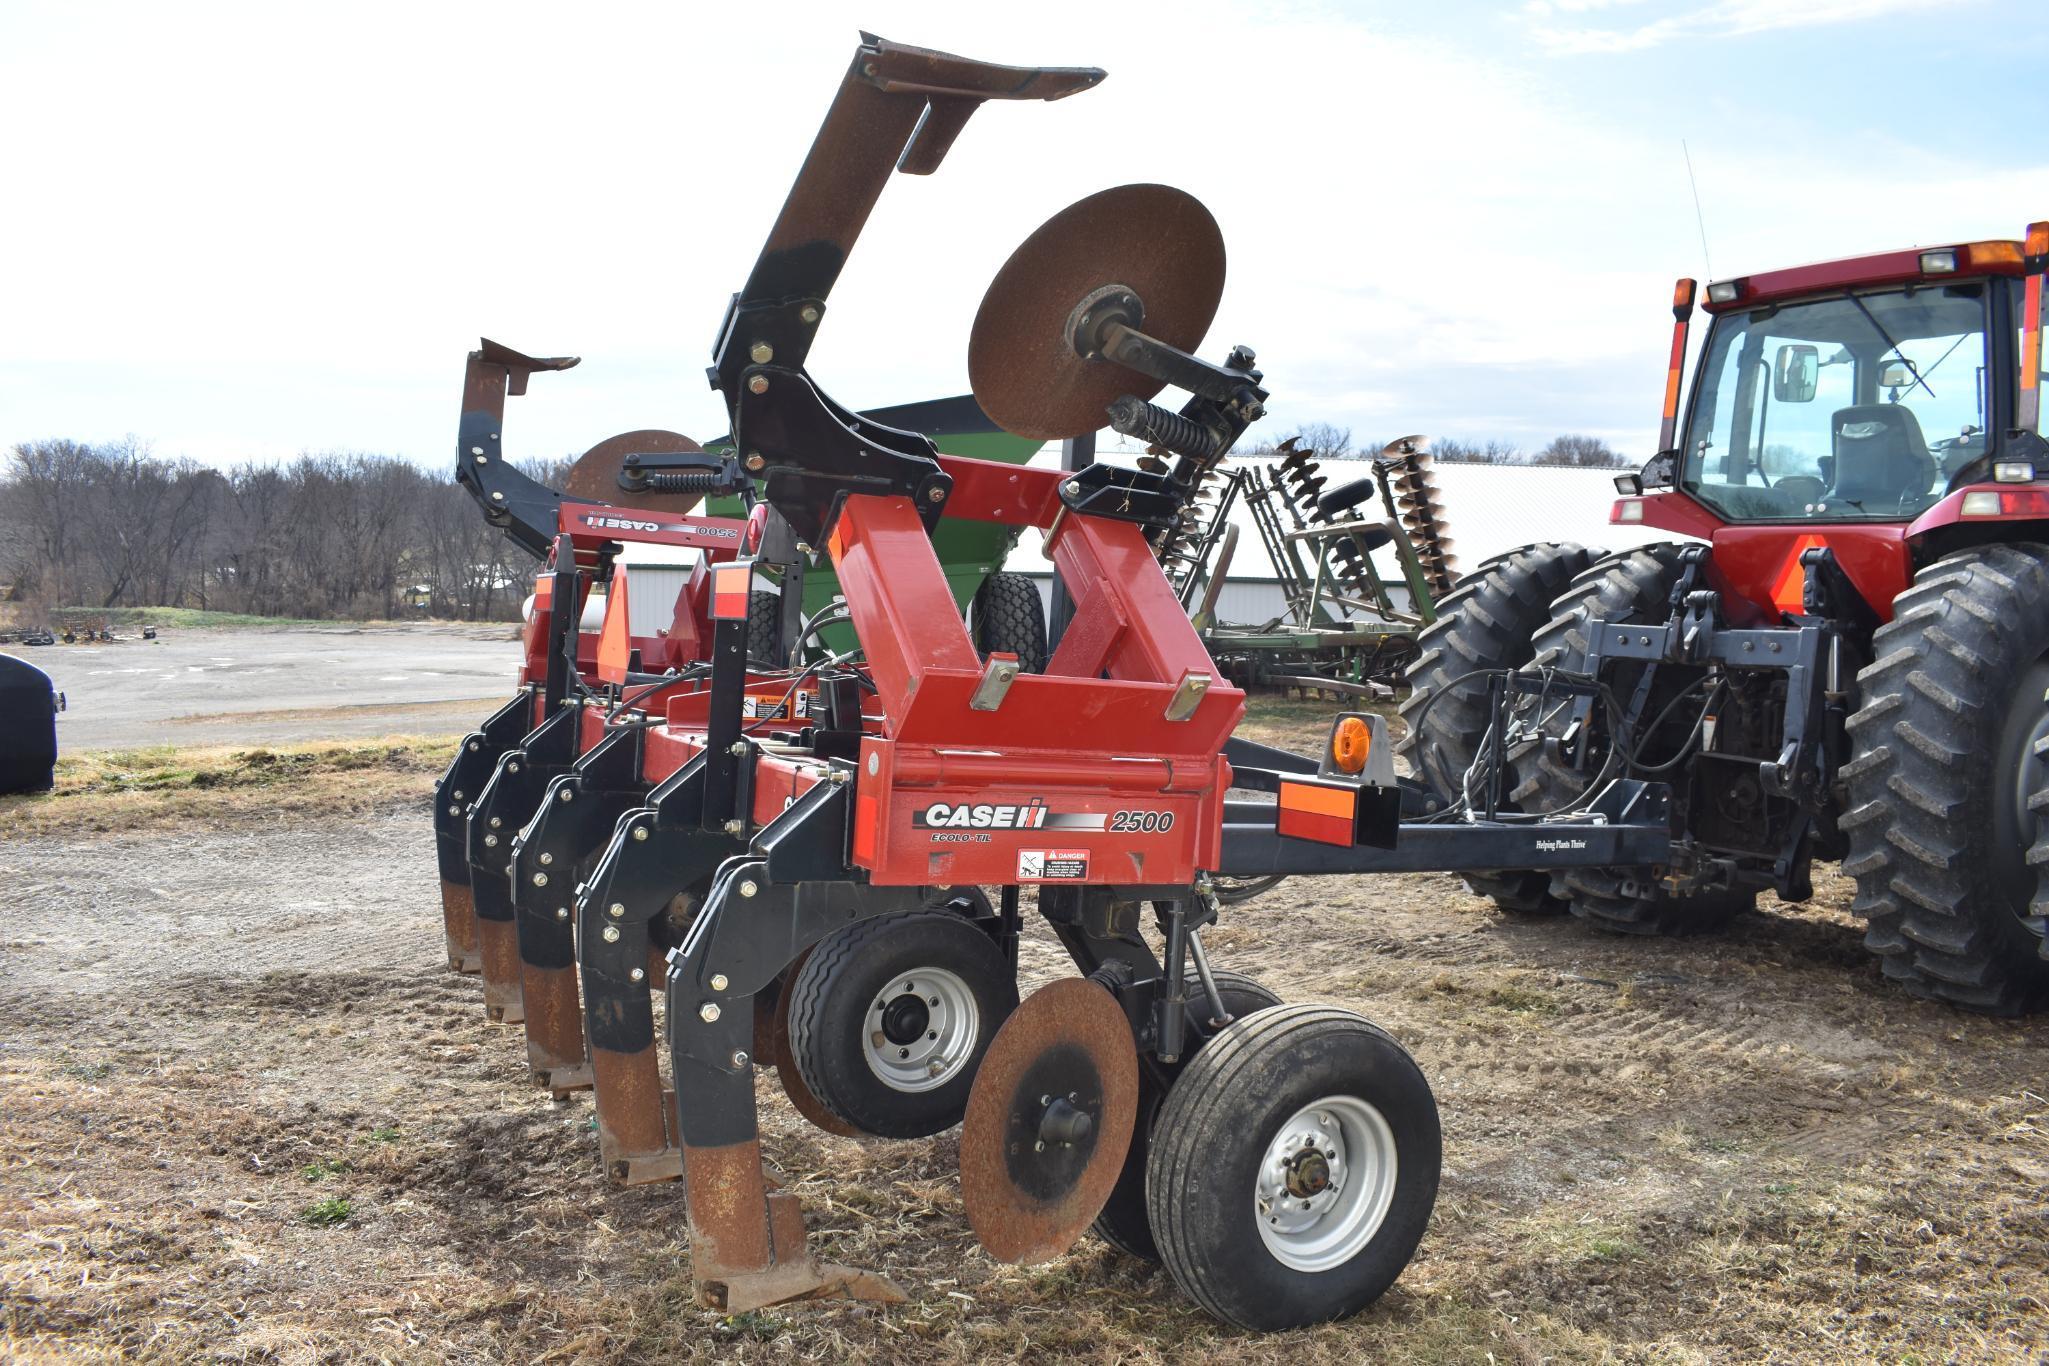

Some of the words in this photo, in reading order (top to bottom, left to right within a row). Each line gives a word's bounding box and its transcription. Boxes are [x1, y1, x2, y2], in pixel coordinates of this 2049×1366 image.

[697, 526, 738, 538] 2500
[1109, 810, 1174, 833] 2500
[1536, 840, 1555, 851] Helping
[1556, 840, 1570, 849] Plants
